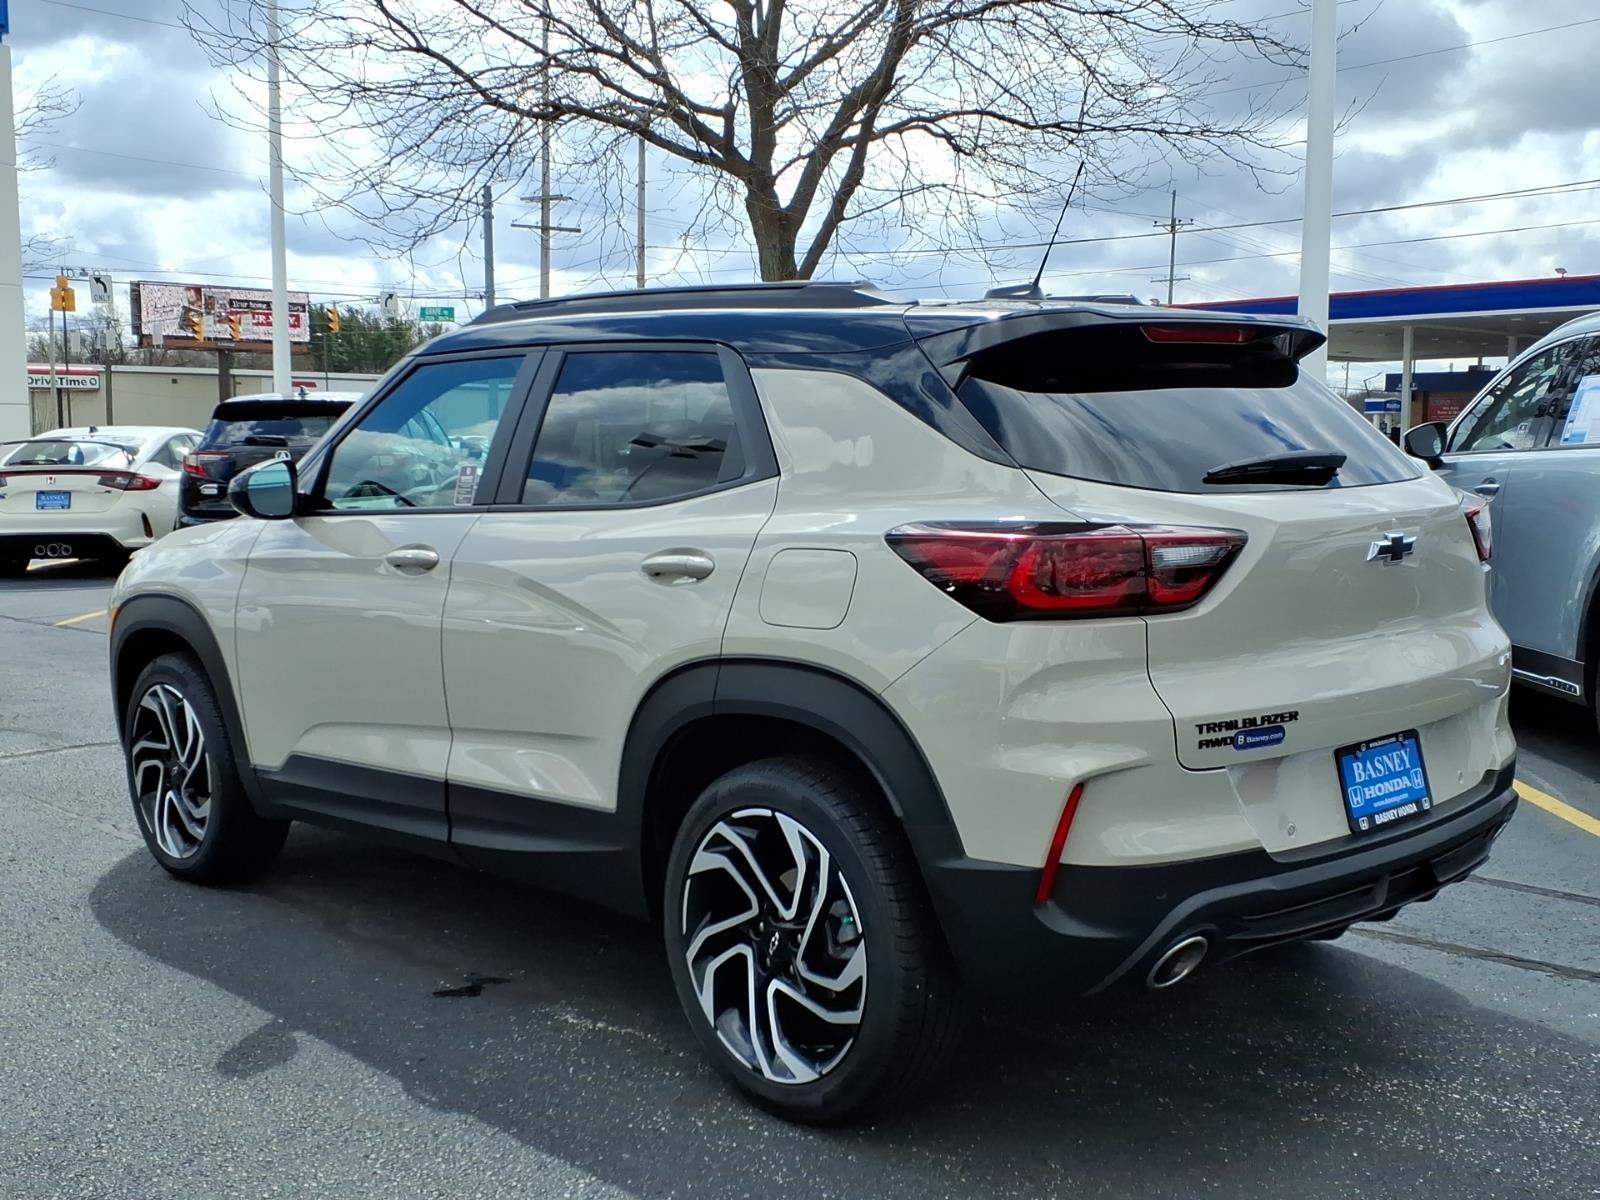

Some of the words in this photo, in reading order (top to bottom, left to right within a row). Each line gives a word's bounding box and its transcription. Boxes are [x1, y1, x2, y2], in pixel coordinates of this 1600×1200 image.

[1195, 711, 1299, 735] TRAILBLAZER
[1352, 748, 1411, 783] BASNEY
[1363, 776, 1412, 799] HONDA
[1374, 808, 1398, 825] BASNEY
